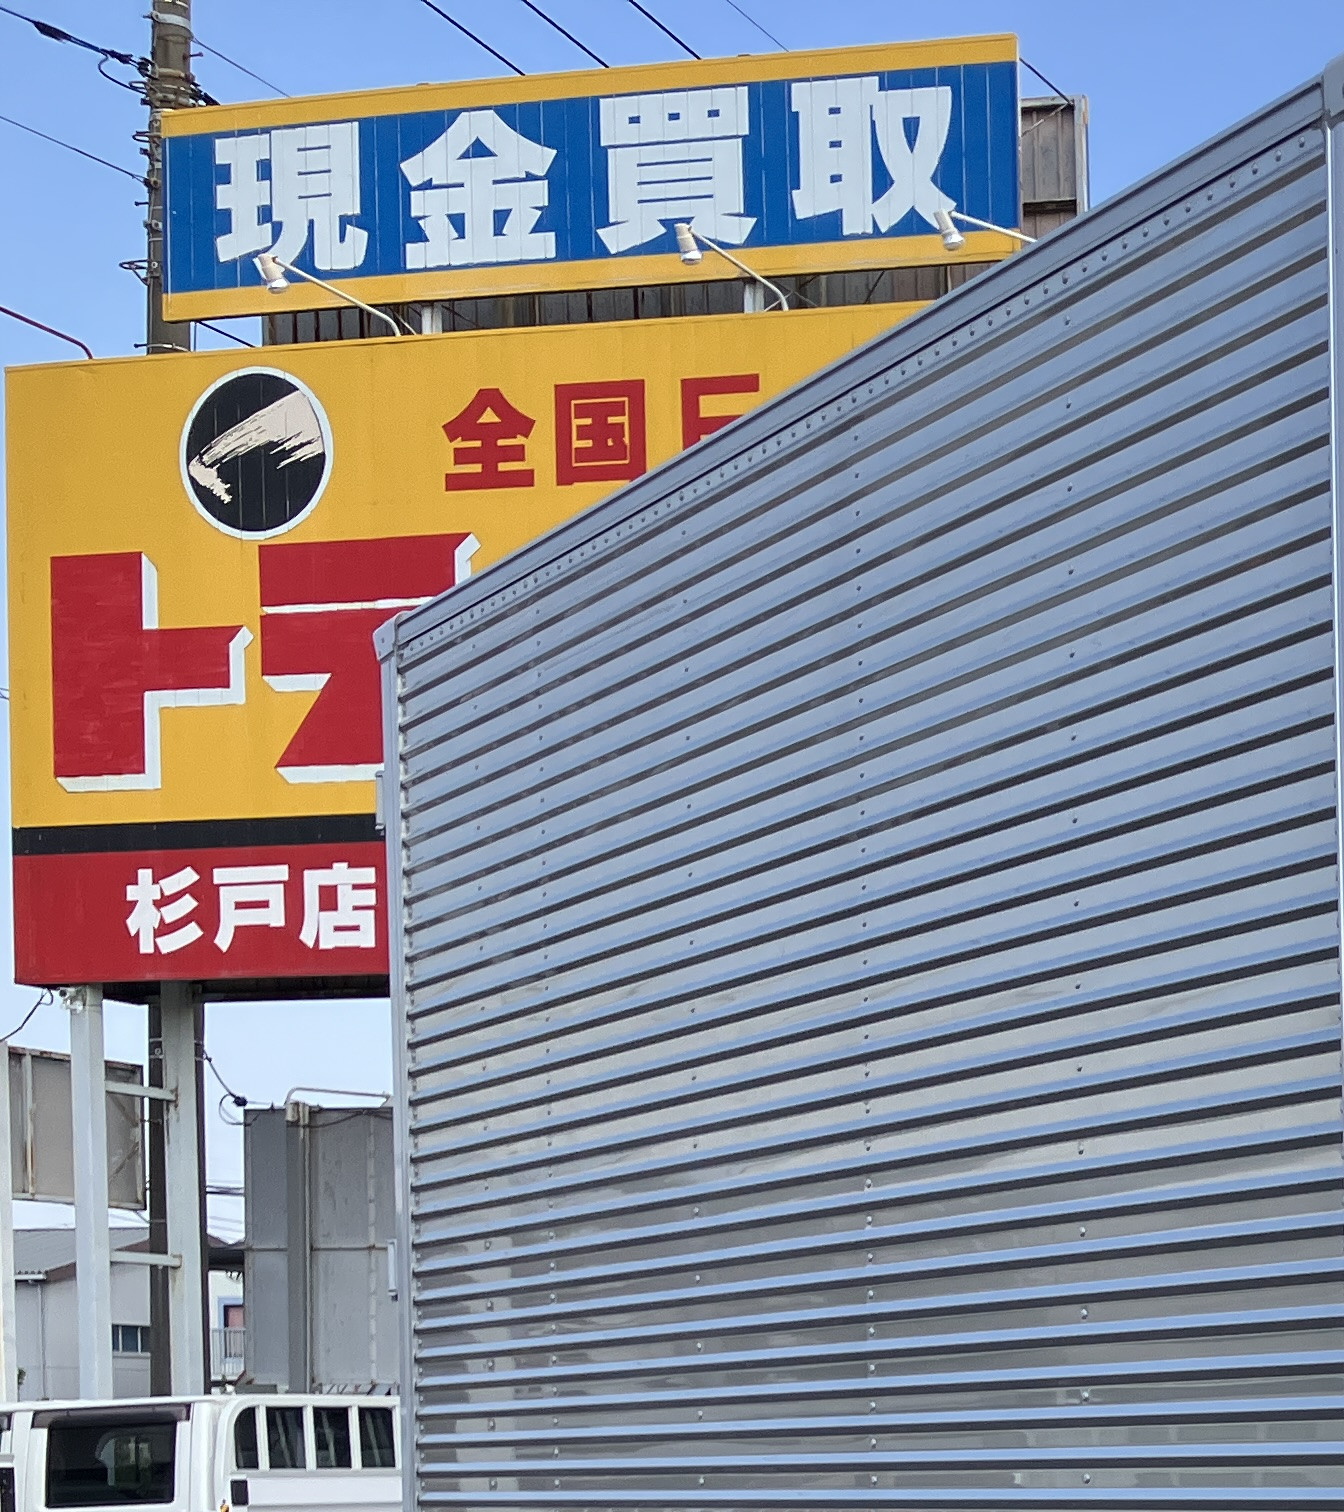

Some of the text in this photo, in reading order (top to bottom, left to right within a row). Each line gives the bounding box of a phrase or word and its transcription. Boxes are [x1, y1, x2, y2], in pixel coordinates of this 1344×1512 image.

[213, 75, 955, 271] 現金買取
[125, 861, 377, 955] 杉戸店
